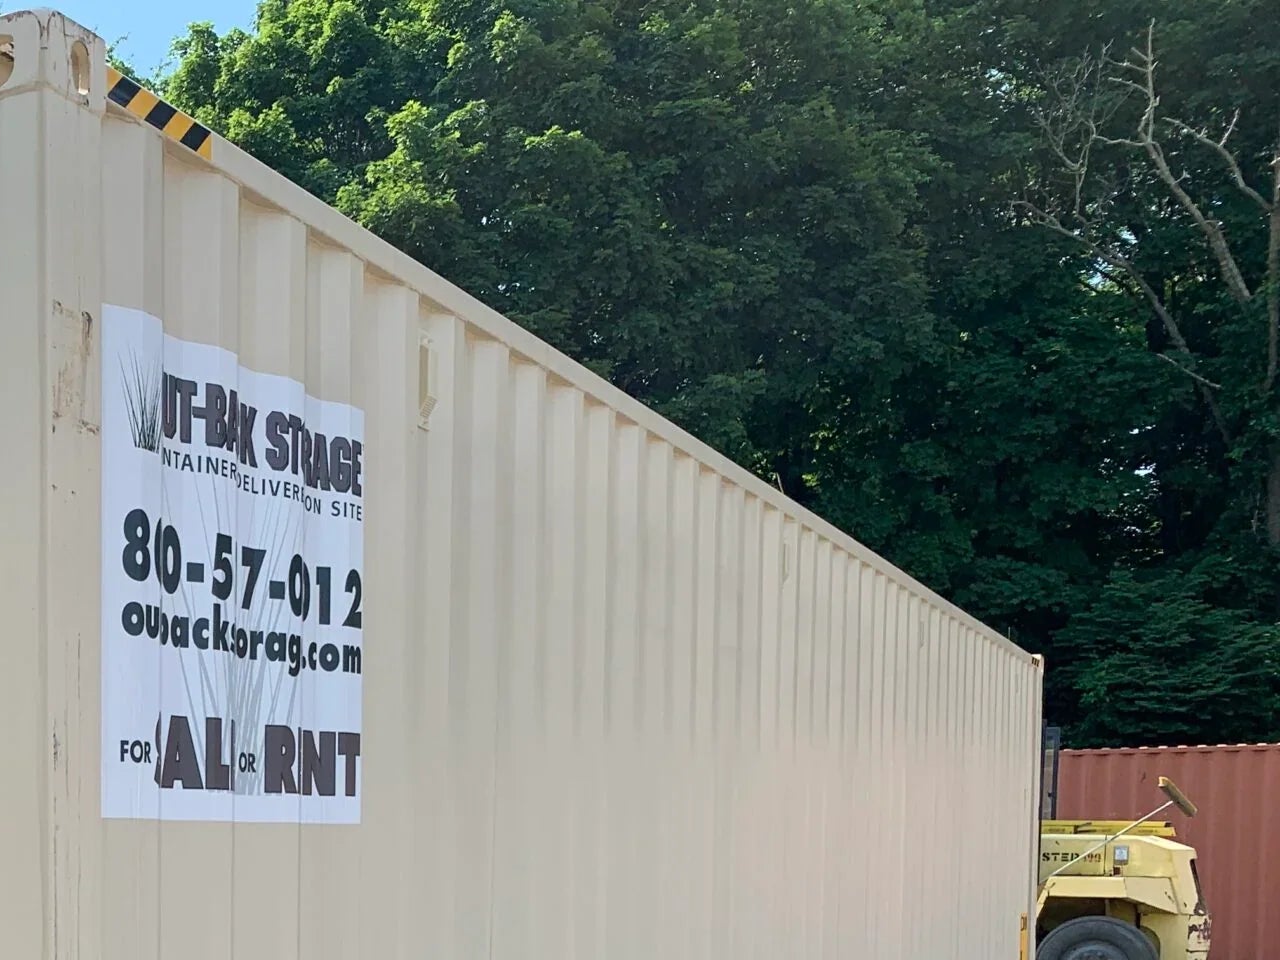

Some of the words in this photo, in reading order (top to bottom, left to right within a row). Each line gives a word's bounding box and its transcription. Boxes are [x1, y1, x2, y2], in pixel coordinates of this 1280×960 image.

[162, 371, 258, 469] UT-BAK
[265, 410, 363, 498] STRAGE
[163, 448, 237, 480] NTAINER
[304, 494, 322, 515] ON
[331, 500, 362, 521] SITE
[122, 508, 362, 629] 80-57-012
[120, 740, 151, 763] FOR
[238, 752, 257, 773] OR
[264, 724, 361, 797] RNT
